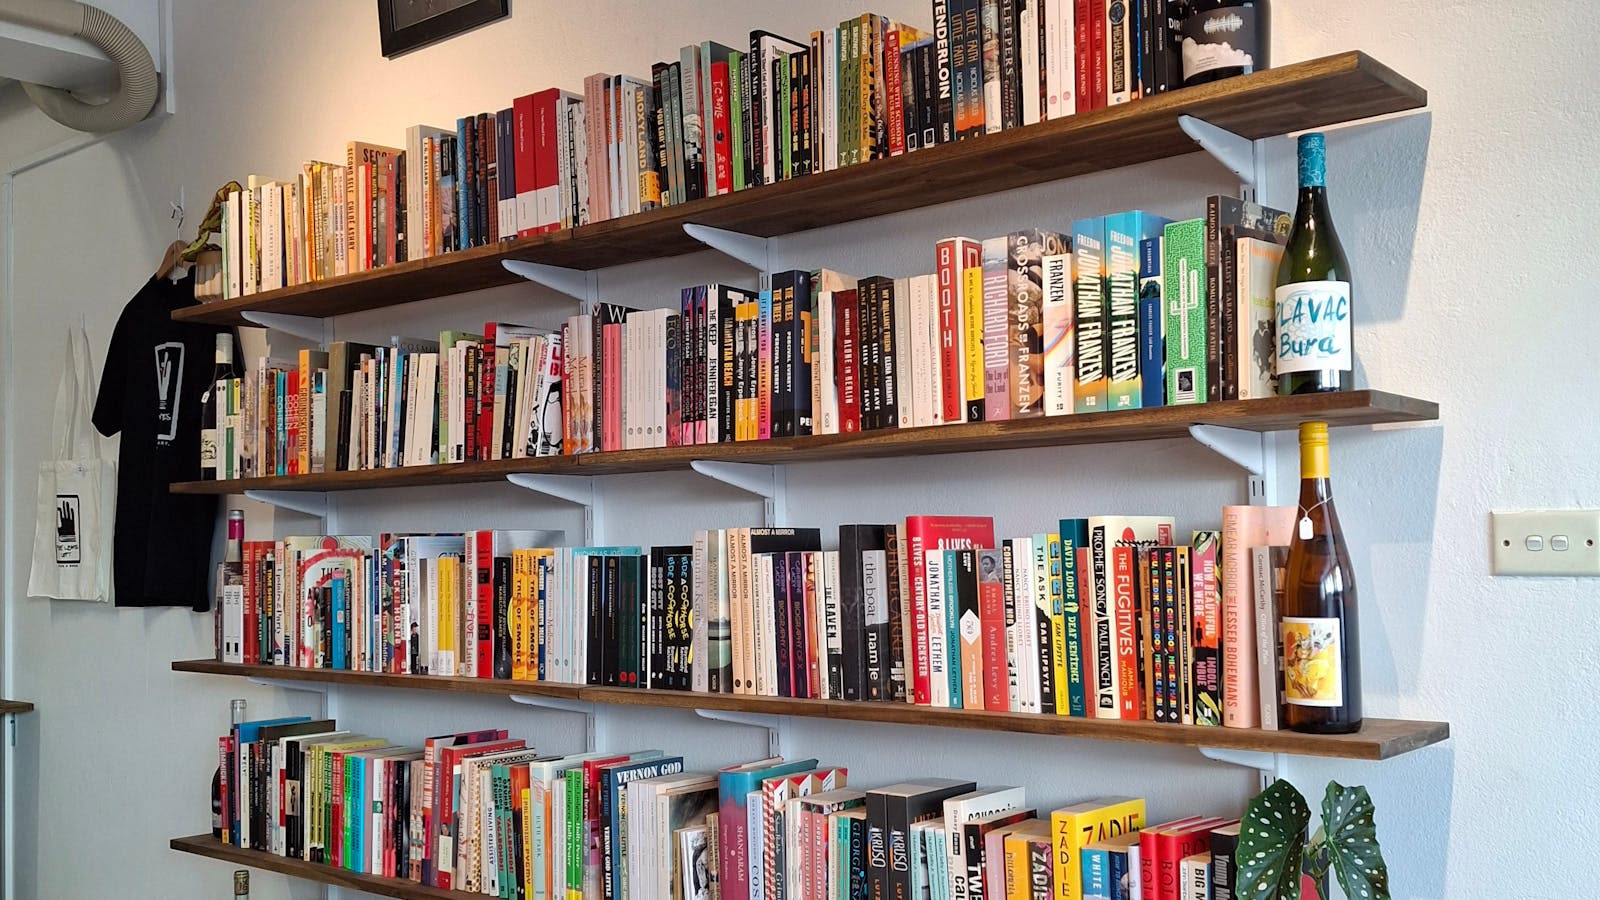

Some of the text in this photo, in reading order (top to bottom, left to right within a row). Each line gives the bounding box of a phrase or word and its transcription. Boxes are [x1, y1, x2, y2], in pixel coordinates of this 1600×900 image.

[951, 13, 962, 40] LITTLE
[1004, 0, 1014, 75] SLEEPERS
[750, 47, 758, 73] Lucky
[934, 0, 950, 99] TENDERLOIN
[952, 45, 964, 67] FAITH
[1113, 26, 1125, 90] MICHAEL CHABON
[634, 90, 645, 168] MOXYLAND
[773, 289, 781, 301] THE
[785, 286, 793, 299] THE
[1049, 259, 1064, 302] FRANZEN
[773, 302, 781, 323] TREES
[785, 301, 793, 321] TREES
[984, 275, 1009, 368] RICHARD FORD
[1016, 235, 1030, 413] CROSSROADS FRANZEN
[1078, 248, 1102, 386] JONATHAN FRANZEN
[1111, 246, 1136, 384] JONATHAN FRANZEN
[667, 321, 676, 349] ECO
[723, 318, 733, 360] MANHATTAN
[844, 339, 852, 363] ALONE
[578, 356, 587, 392] Mural
[708, 358, 716, 394] JENNIFER
[724, 362, 733, 386] BEACH
[845, 376, 853, 404] BERLIN
[299, 388, 307, 452] GROUNDSKEEPING
[667, 556, 676, 577] RIDE
[913, 543, 922, 566] LIVES
[1036, 546, 1044, 572] THE
[694, 540, 703, 622] Hannah Kent
[865, 563, 874, 584] the
[1038, 576, 1046, 601] ASK
[1166, 570, 1174, 606] BLEEDING
[666, 585, 676, 640] COCKHORSE
[866, 588, 876, 616] boat
[915, 576, 924, 629] CENTURY-OLD
[1064, 539, 1079, 684] DAVID LODGE DEAF SENTENCE
[1093, 529, 1110, 686] PROPHET SONG PAUL LYNCH
[1117, 552, 1132, 656] THE FUGITIVES
[1194, 573, 1204, 616] WE WERE
[1204, 560, 1215, 636] HOW BEAUTIFUL
[1227, 514, 1238, 707] EIMEAR MCBRIDE LESSER BOHEMIANS
[827, 603, 836, 638] RAVEN
[929, 560, 942, 672] JONATHAN LETHEM
[1166, 608, 1174, 652] CHILDHOOD
[918, 632, 927, 676] TRICKSTER
[989, 626, 999, 689] Andrea Levy
[1168, 656, 1176, 687] MICHELE
[870, 668, 879, 680] le
[1042, 652, 1050, 694] LIPSYTE
[1120, 661, 1128, 696] MAHJOUB
[1196, 662, 1206, 686] MBUE
[1207, 657, 1216, 691] IMBOLO
[617, 762, 681, 784] VERNON GOD
[871, 832, 886, 867] KRUSO
[893, 835, 908, 870] KRUSO
[1059, 820, 1069, 897] ZADIE
[1092, 854, 1102, 891] WHITE
[1195, 868, 1206, 890] BIG
[1212, 854, 1230, 885] Young
